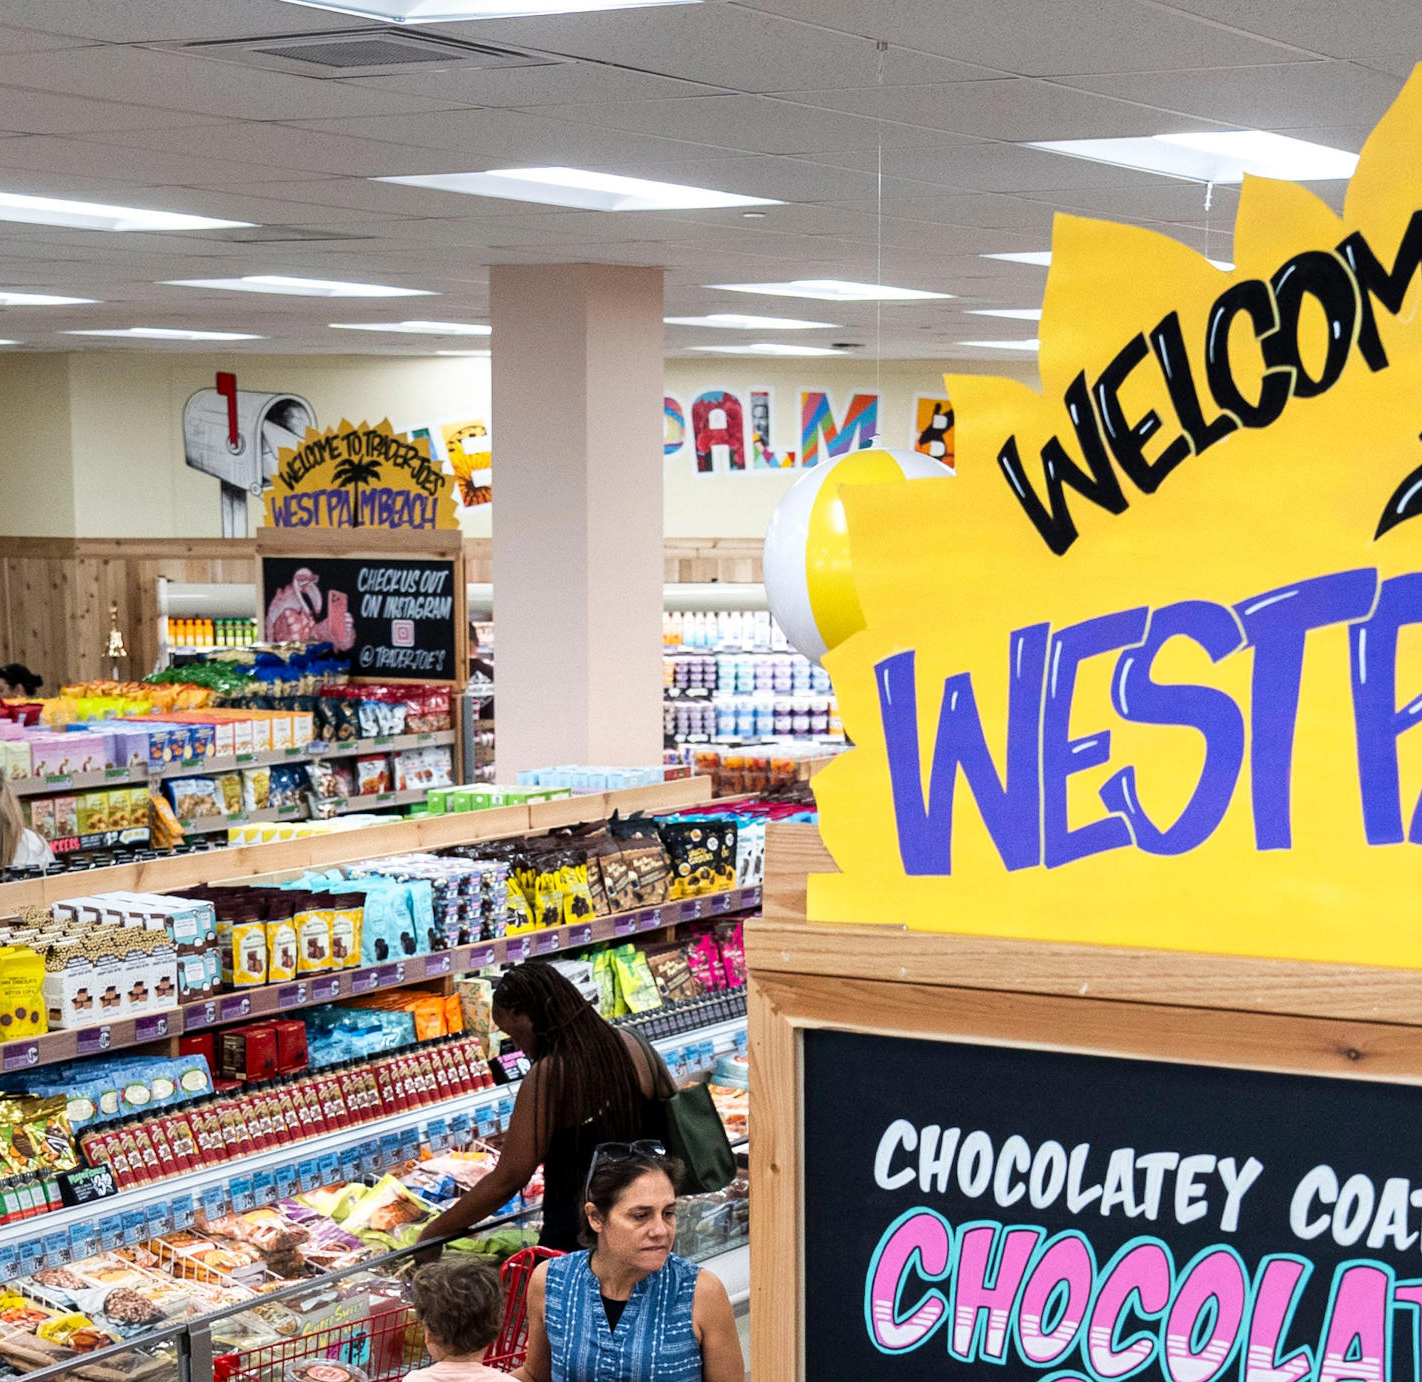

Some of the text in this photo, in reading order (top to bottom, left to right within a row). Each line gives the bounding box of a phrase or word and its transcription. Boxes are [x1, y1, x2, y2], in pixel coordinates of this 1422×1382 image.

[279, 435, 342, 491] WELCOME
[342, 430, 363, 458] TO
[363, 430, 418, 469] TRADER
[271, 487, 439, 530] WEST PALM BEACH
[357, 567, 450, 594] CHECK US OUT
[361, 595, 453, 620] ON INSTAGRAM
[873, 566, 1379, 877] WEST
[873, 1118, 1264, 1233] CHOCOLATEY
